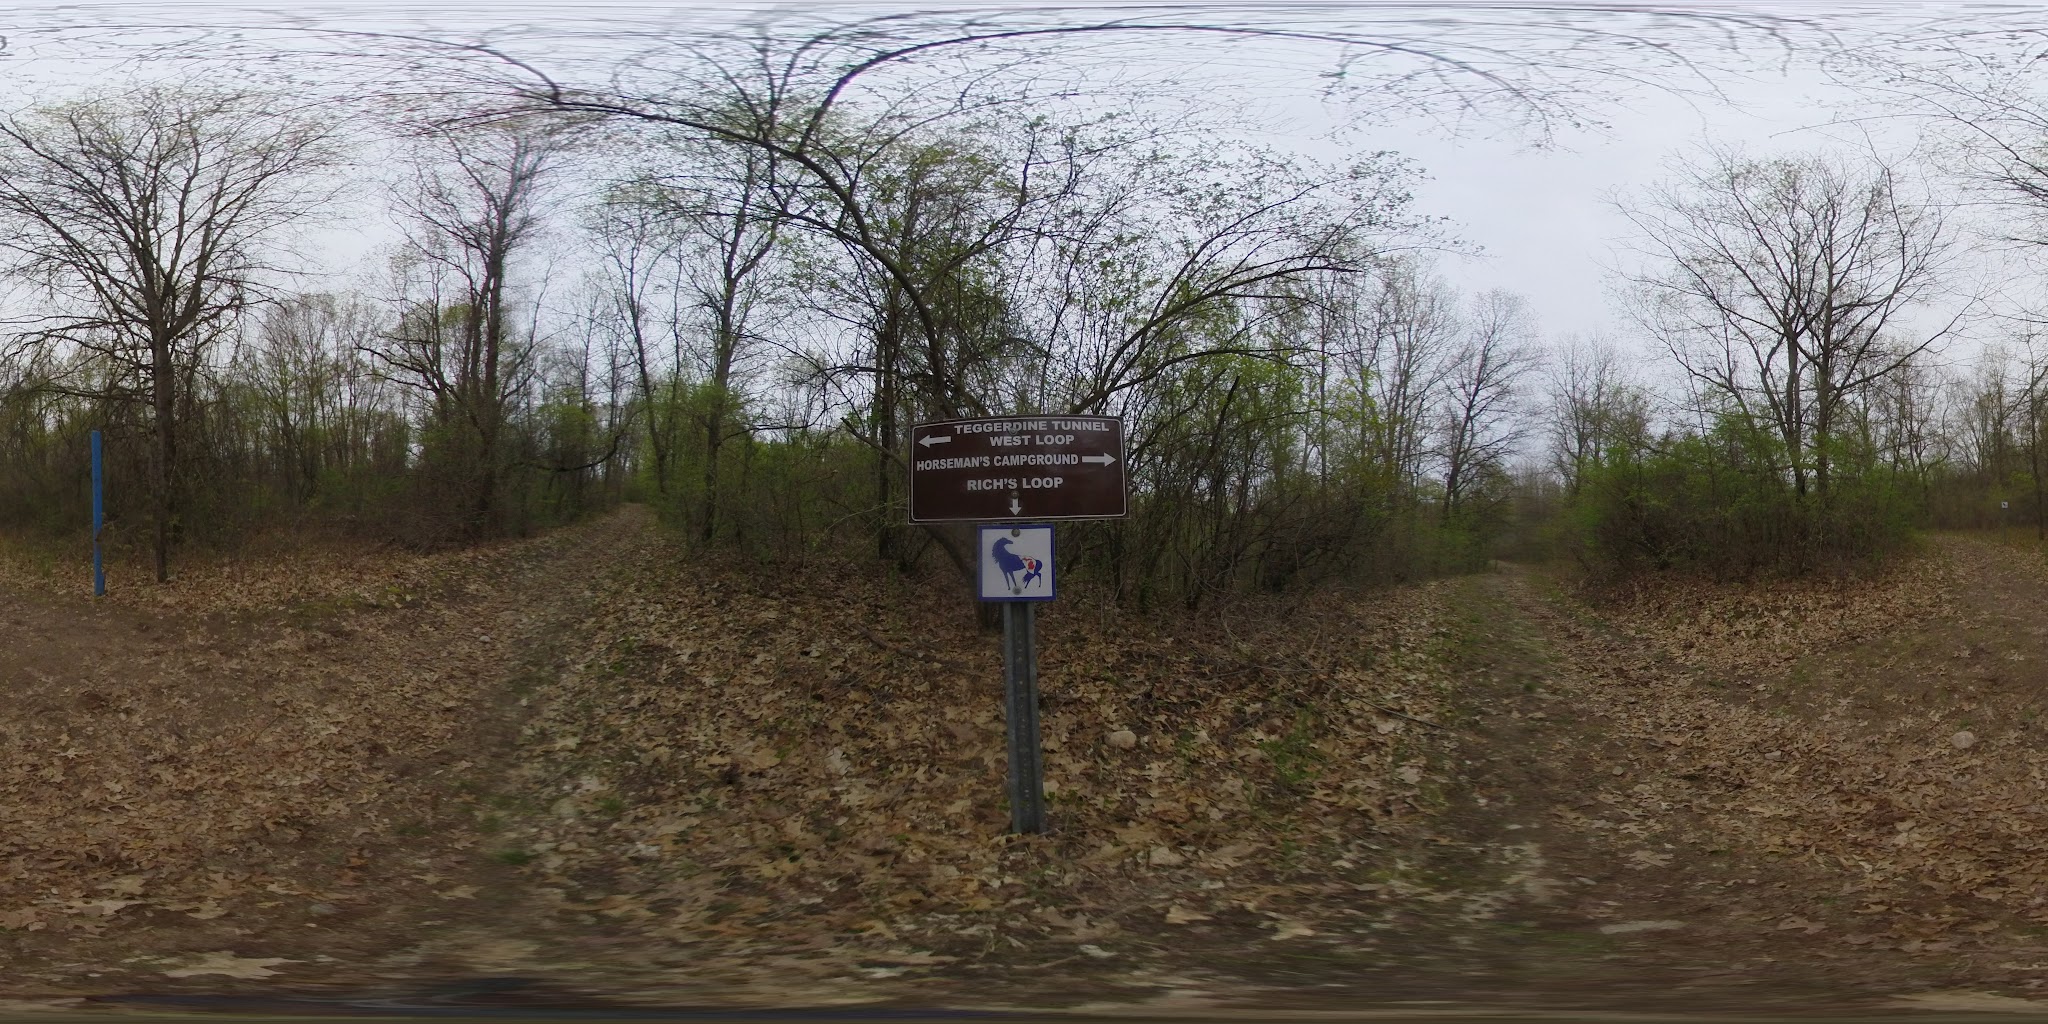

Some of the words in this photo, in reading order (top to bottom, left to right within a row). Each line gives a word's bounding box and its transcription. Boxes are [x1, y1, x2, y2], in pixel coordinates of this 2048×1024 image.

[954, 421, 1048, 435] TEGGERDINE
[1052, 420, 1110, 431] TUNNEL
[990, 435, 1031, 446] WEST
[1035, 434, 1075, 445] LOOP
[916, 455, 990, 471] HORSEMAN'S
[994, 453, 1079, 467] CAMPGROUND
[967, 478, 1017, 491] RICH'S
[1022, 477, 1063, 489] LOOP
